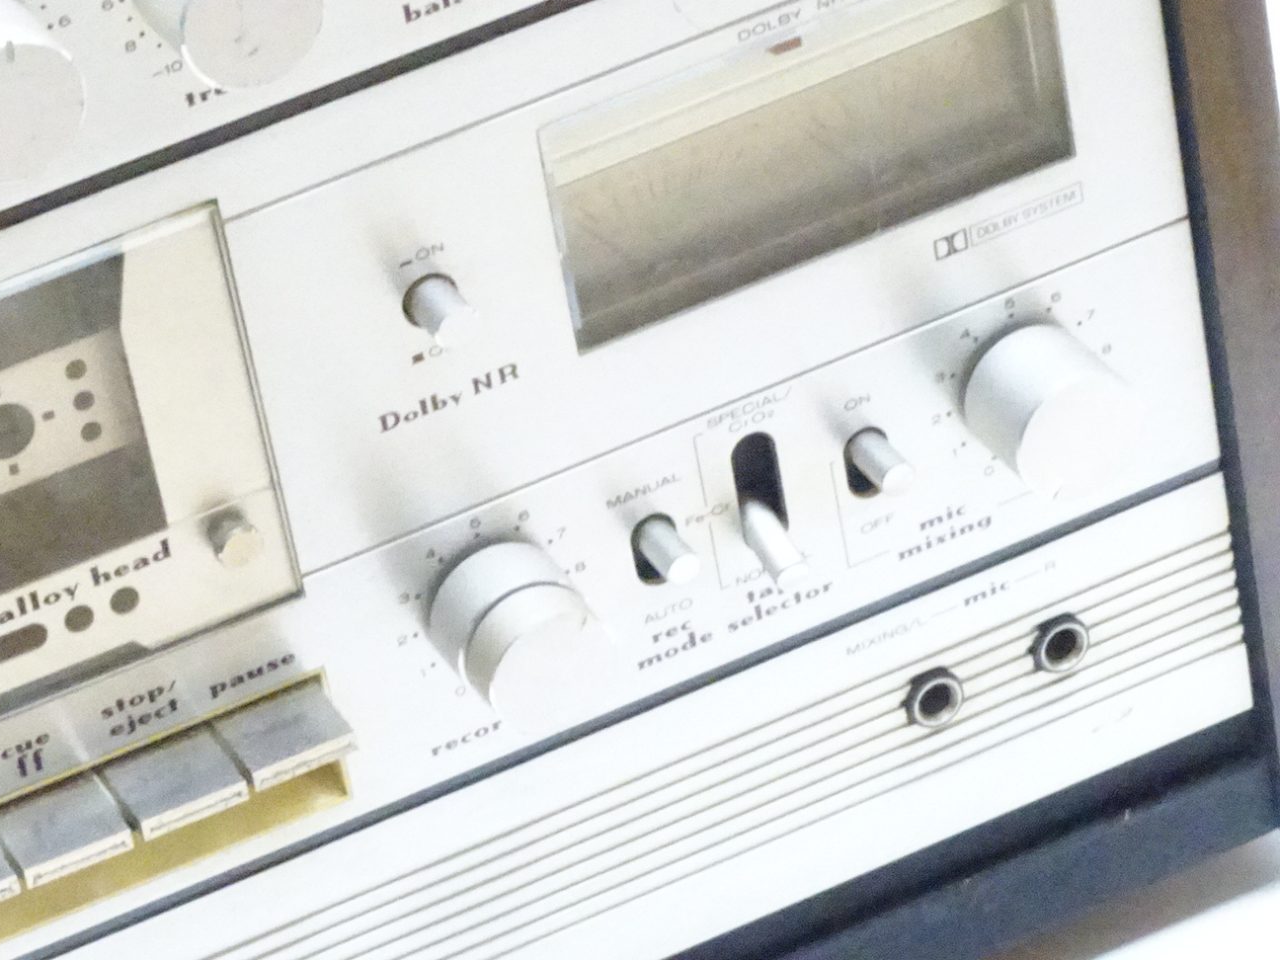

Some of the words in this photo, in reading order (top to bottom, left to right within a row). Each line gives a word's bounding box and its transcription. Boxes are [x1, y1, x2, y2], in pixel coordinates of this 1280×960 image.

[737, 7, 802, 43] DOLBY
[976, 212, 1019, 240] DOLBY
[415, 242, 444, 262] ON
[377, 390, 463, 434] Dolby
[472, 362, 520, 396] NR
[843, 394, 871, 412] ON
[606, 473, 682, 511] MANUAL
[860, 512, 895, 535] OFF
[919, 503, 967, 533] mic
[897, 516, 993, 562] mixing
[89, 537, 173, 588] head
[727, 581, 834, 633] selector
[963, 579, 1011, 608] mic
[644, 597, 694, 625] AUTO
[651, 619, 692, 644] rec
[637, 630, 714, 672] mode
[208, 650, 296, 701] pause
[109, 696, 180, 738] eject
[0, 731, 51, 761] cue
[16, 746, 46, 779] ff
